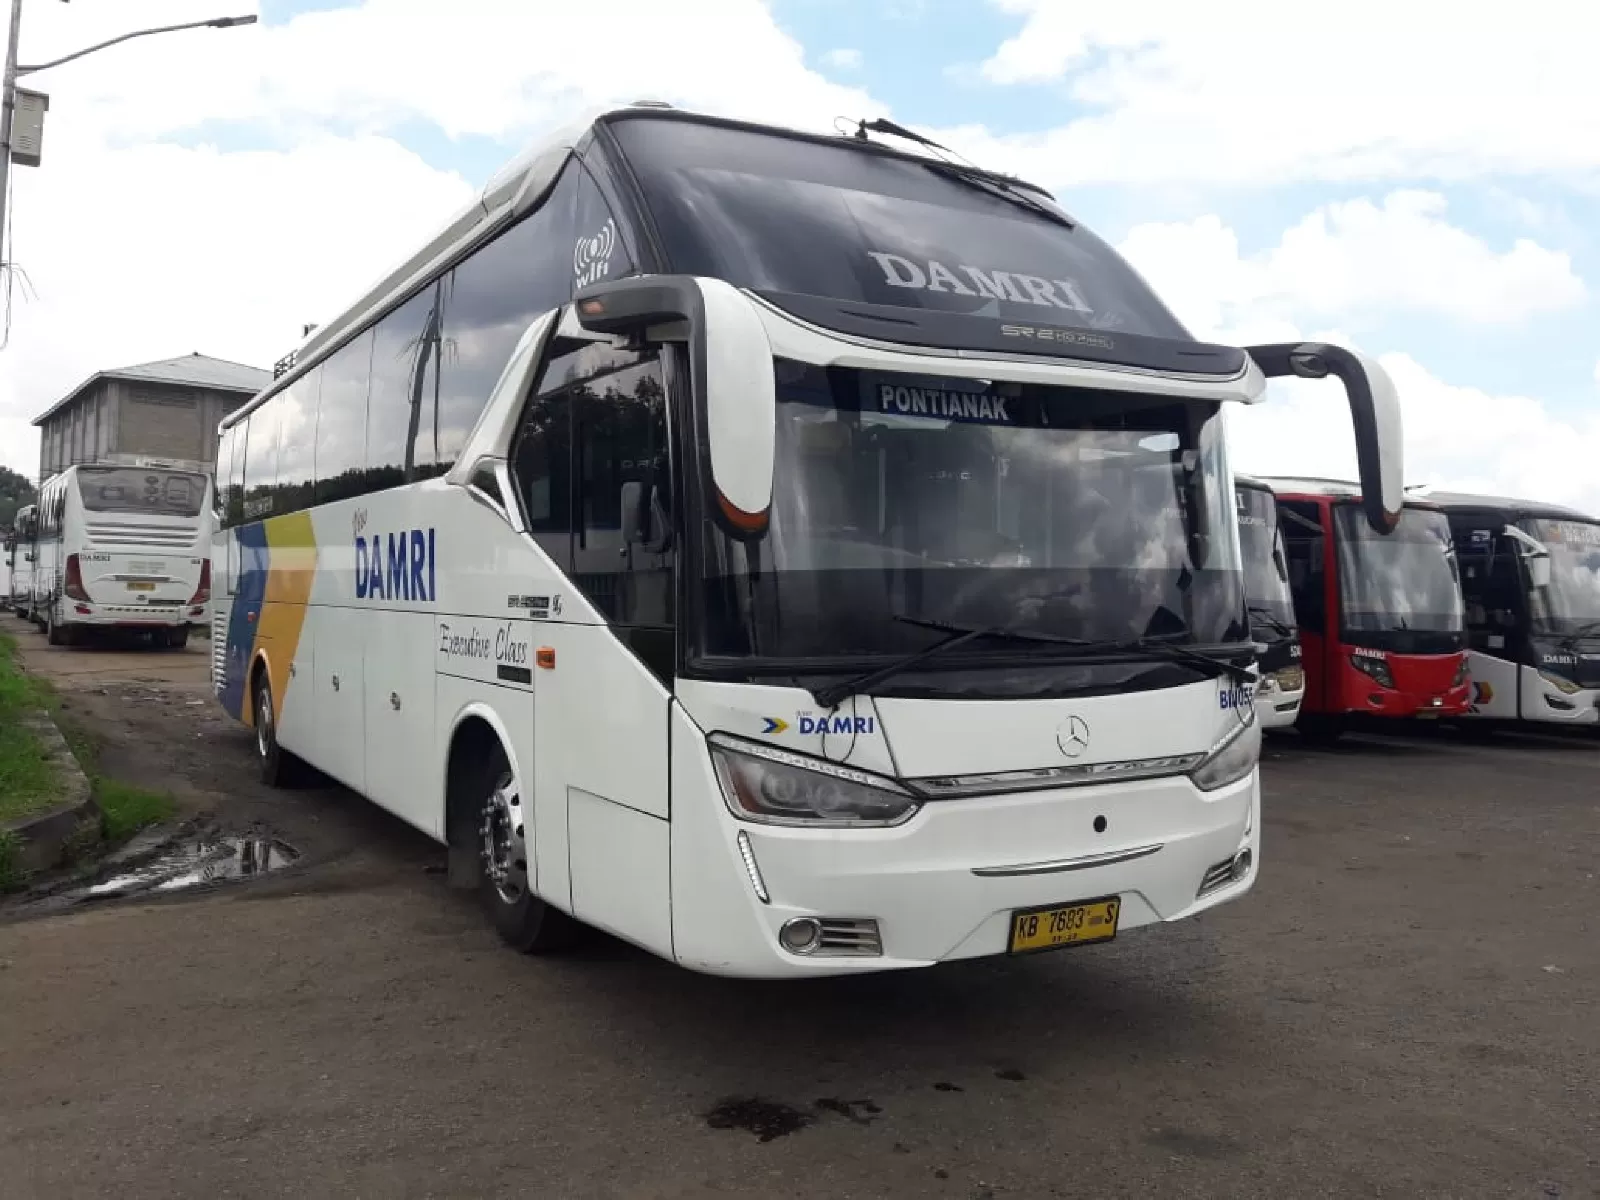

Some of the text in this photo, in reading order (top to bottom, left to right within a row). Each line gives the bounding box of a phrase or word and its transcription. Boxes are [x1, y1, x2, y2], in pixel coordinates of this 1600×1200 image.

[867, 251, 1094, 314] DAMRI
[881, 384, 1010, 422] PONTIANAK
[355, 527, 436, 602] DAMRI
[439, 621, 528, 664] Executive Class
[799, 715, 875, 735] DAMRI
[1018, 916, 1040, 940] KB
[1105, 903, 1116, 925] S
